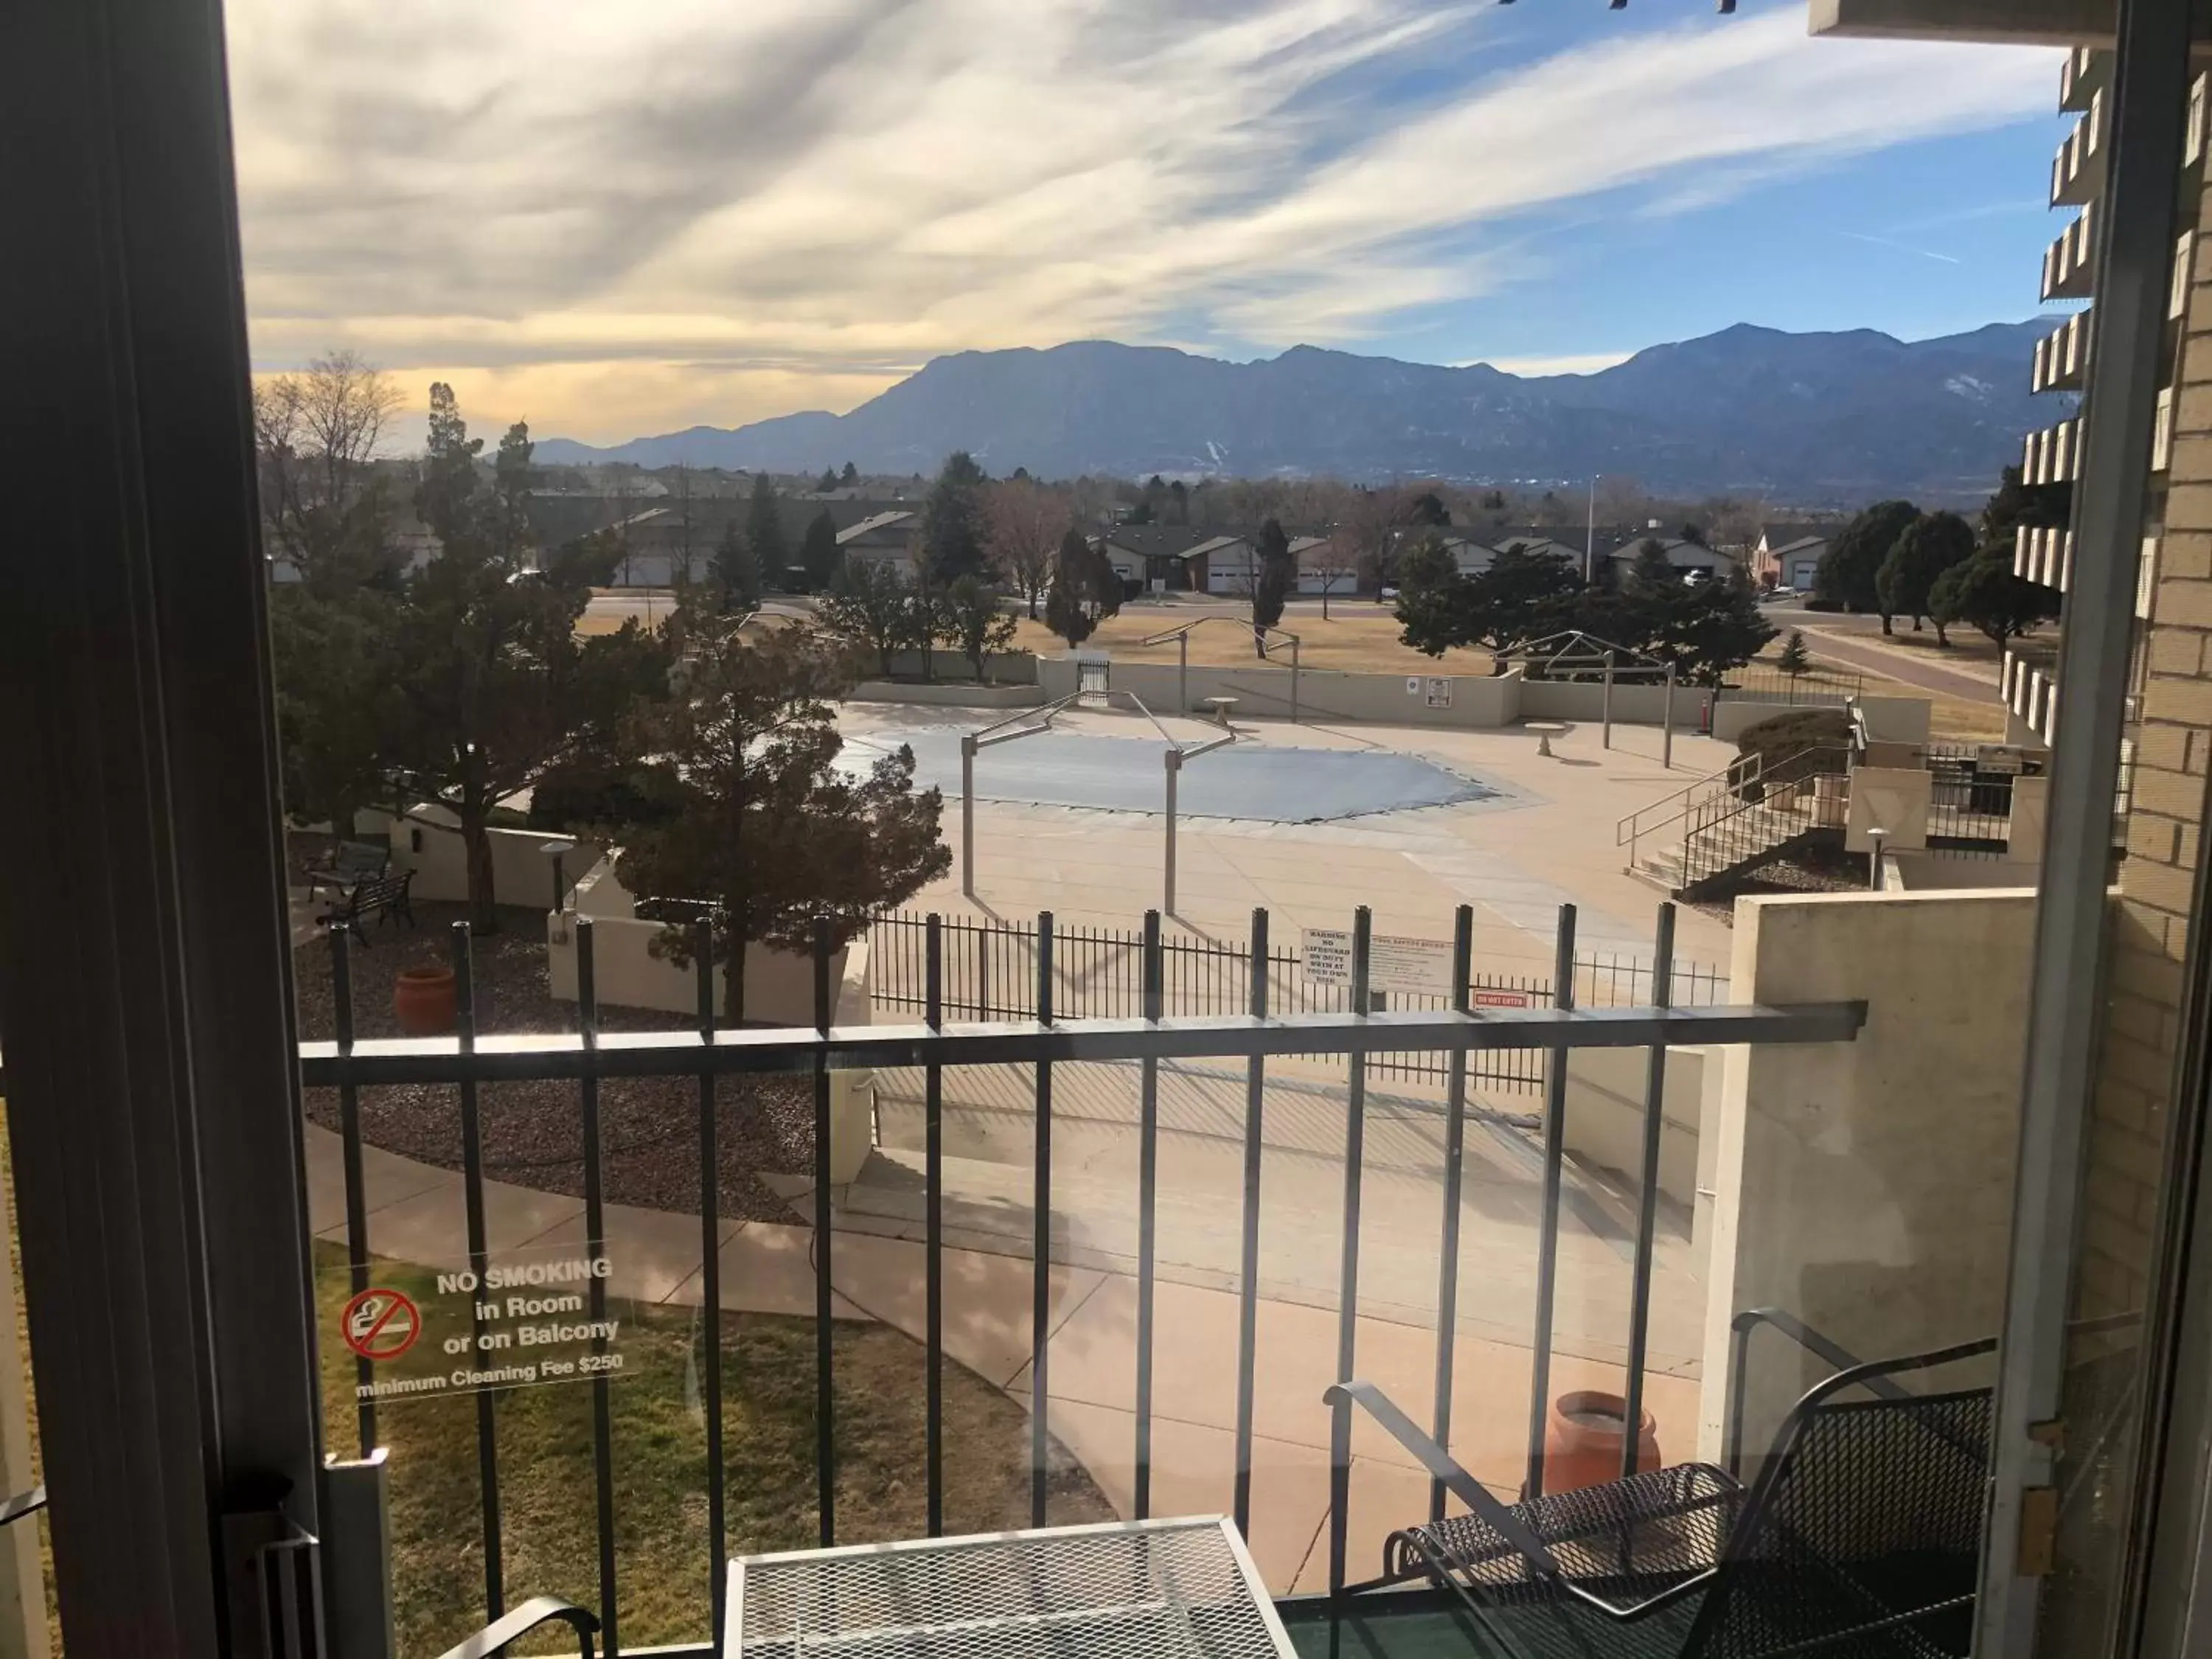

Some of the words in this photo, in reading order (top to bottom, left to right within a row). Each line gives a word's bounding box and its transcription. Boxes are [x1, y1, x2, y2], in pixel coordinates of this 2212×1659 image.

[438, 1273, 478, 1295] NO
[486, 1259, 613, 1289] SMOKING
[476, 1301, 499, 1320] in
[507, 1294, 582, 1318] Room
[443, 1334, 470, 1354] or
[479, 1332, 511, 1349] on
[518, 1321, 619, 1346] Balcony
[355, 1374, 446, 1398] minimum
[451, 1366, 536, 1385] Cleaning
[541, 1360, 574, 1376] Fee
[579, 1354, 623, 1372] $250
